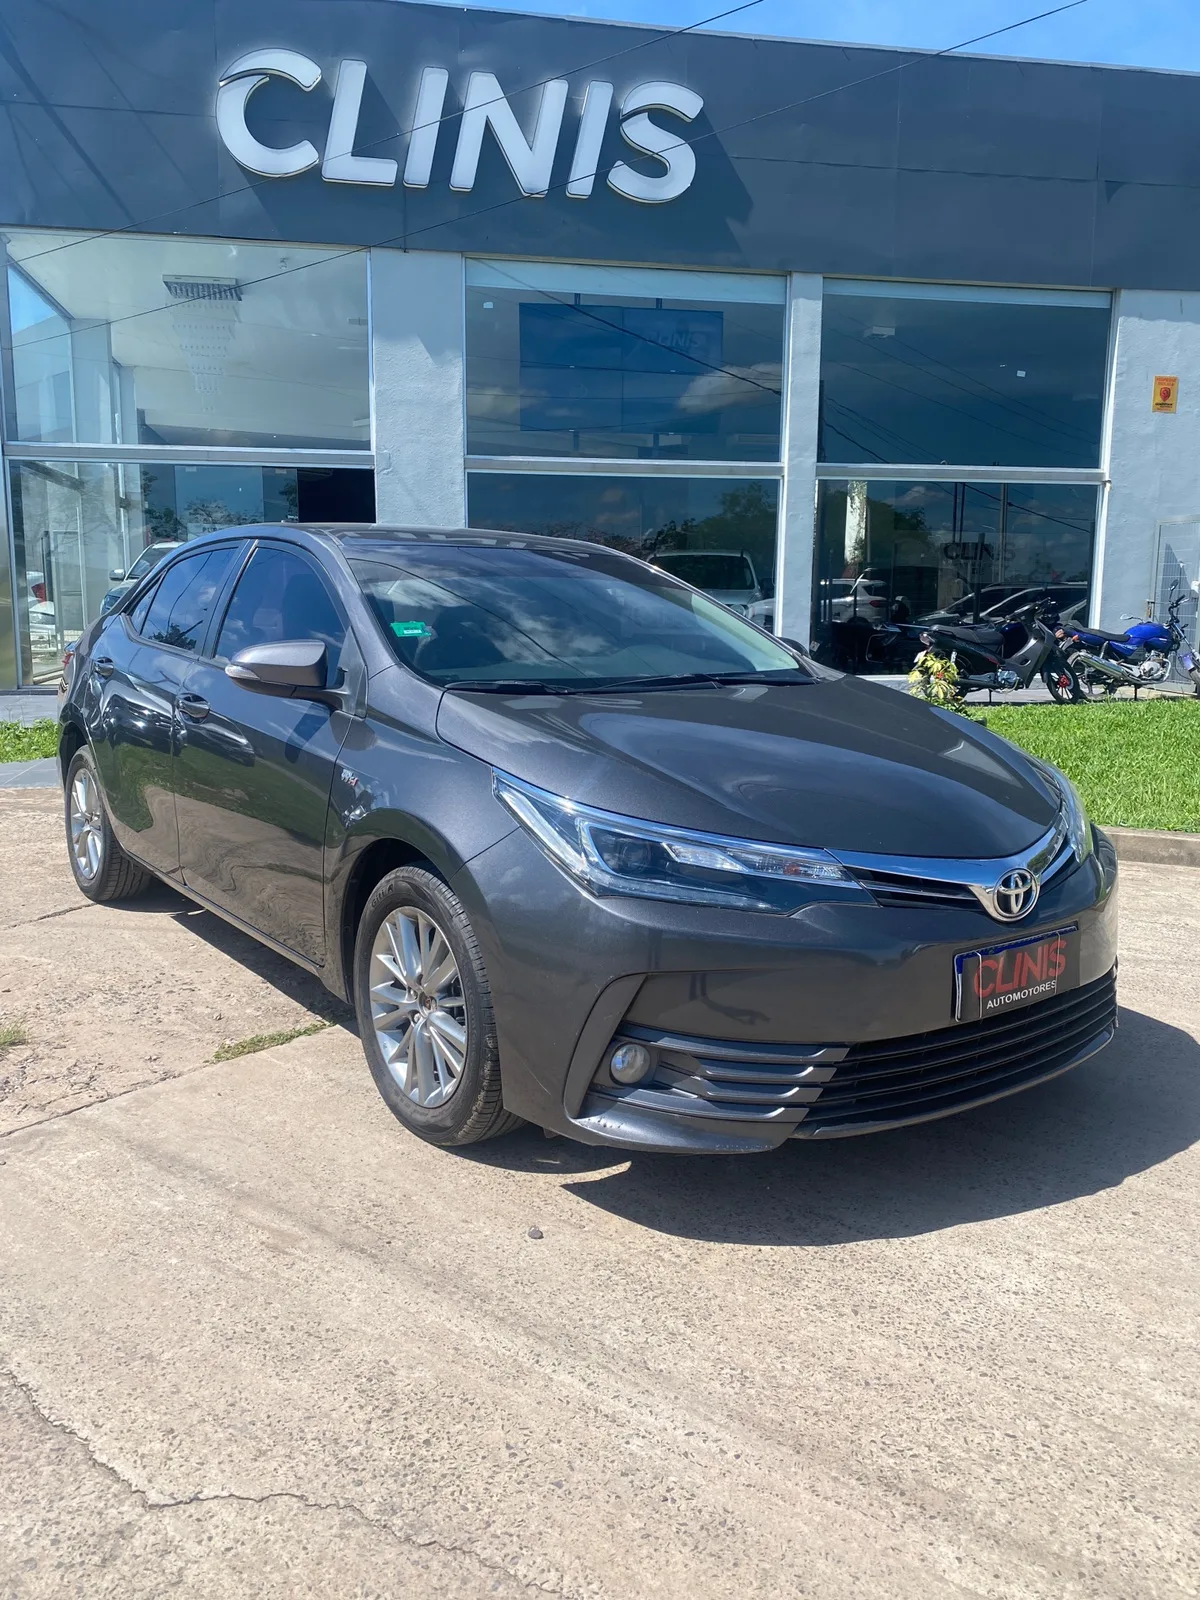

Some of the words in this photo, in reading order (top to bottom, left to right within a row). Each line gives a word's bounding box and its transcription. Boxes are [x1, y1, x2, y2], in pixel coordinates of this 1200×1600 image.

[215, 47, 704, 203] CLINIS
[974, 939, 1067, 998] CLINIS
[986, 980, 1057, 1009] AUTOMOTORES
